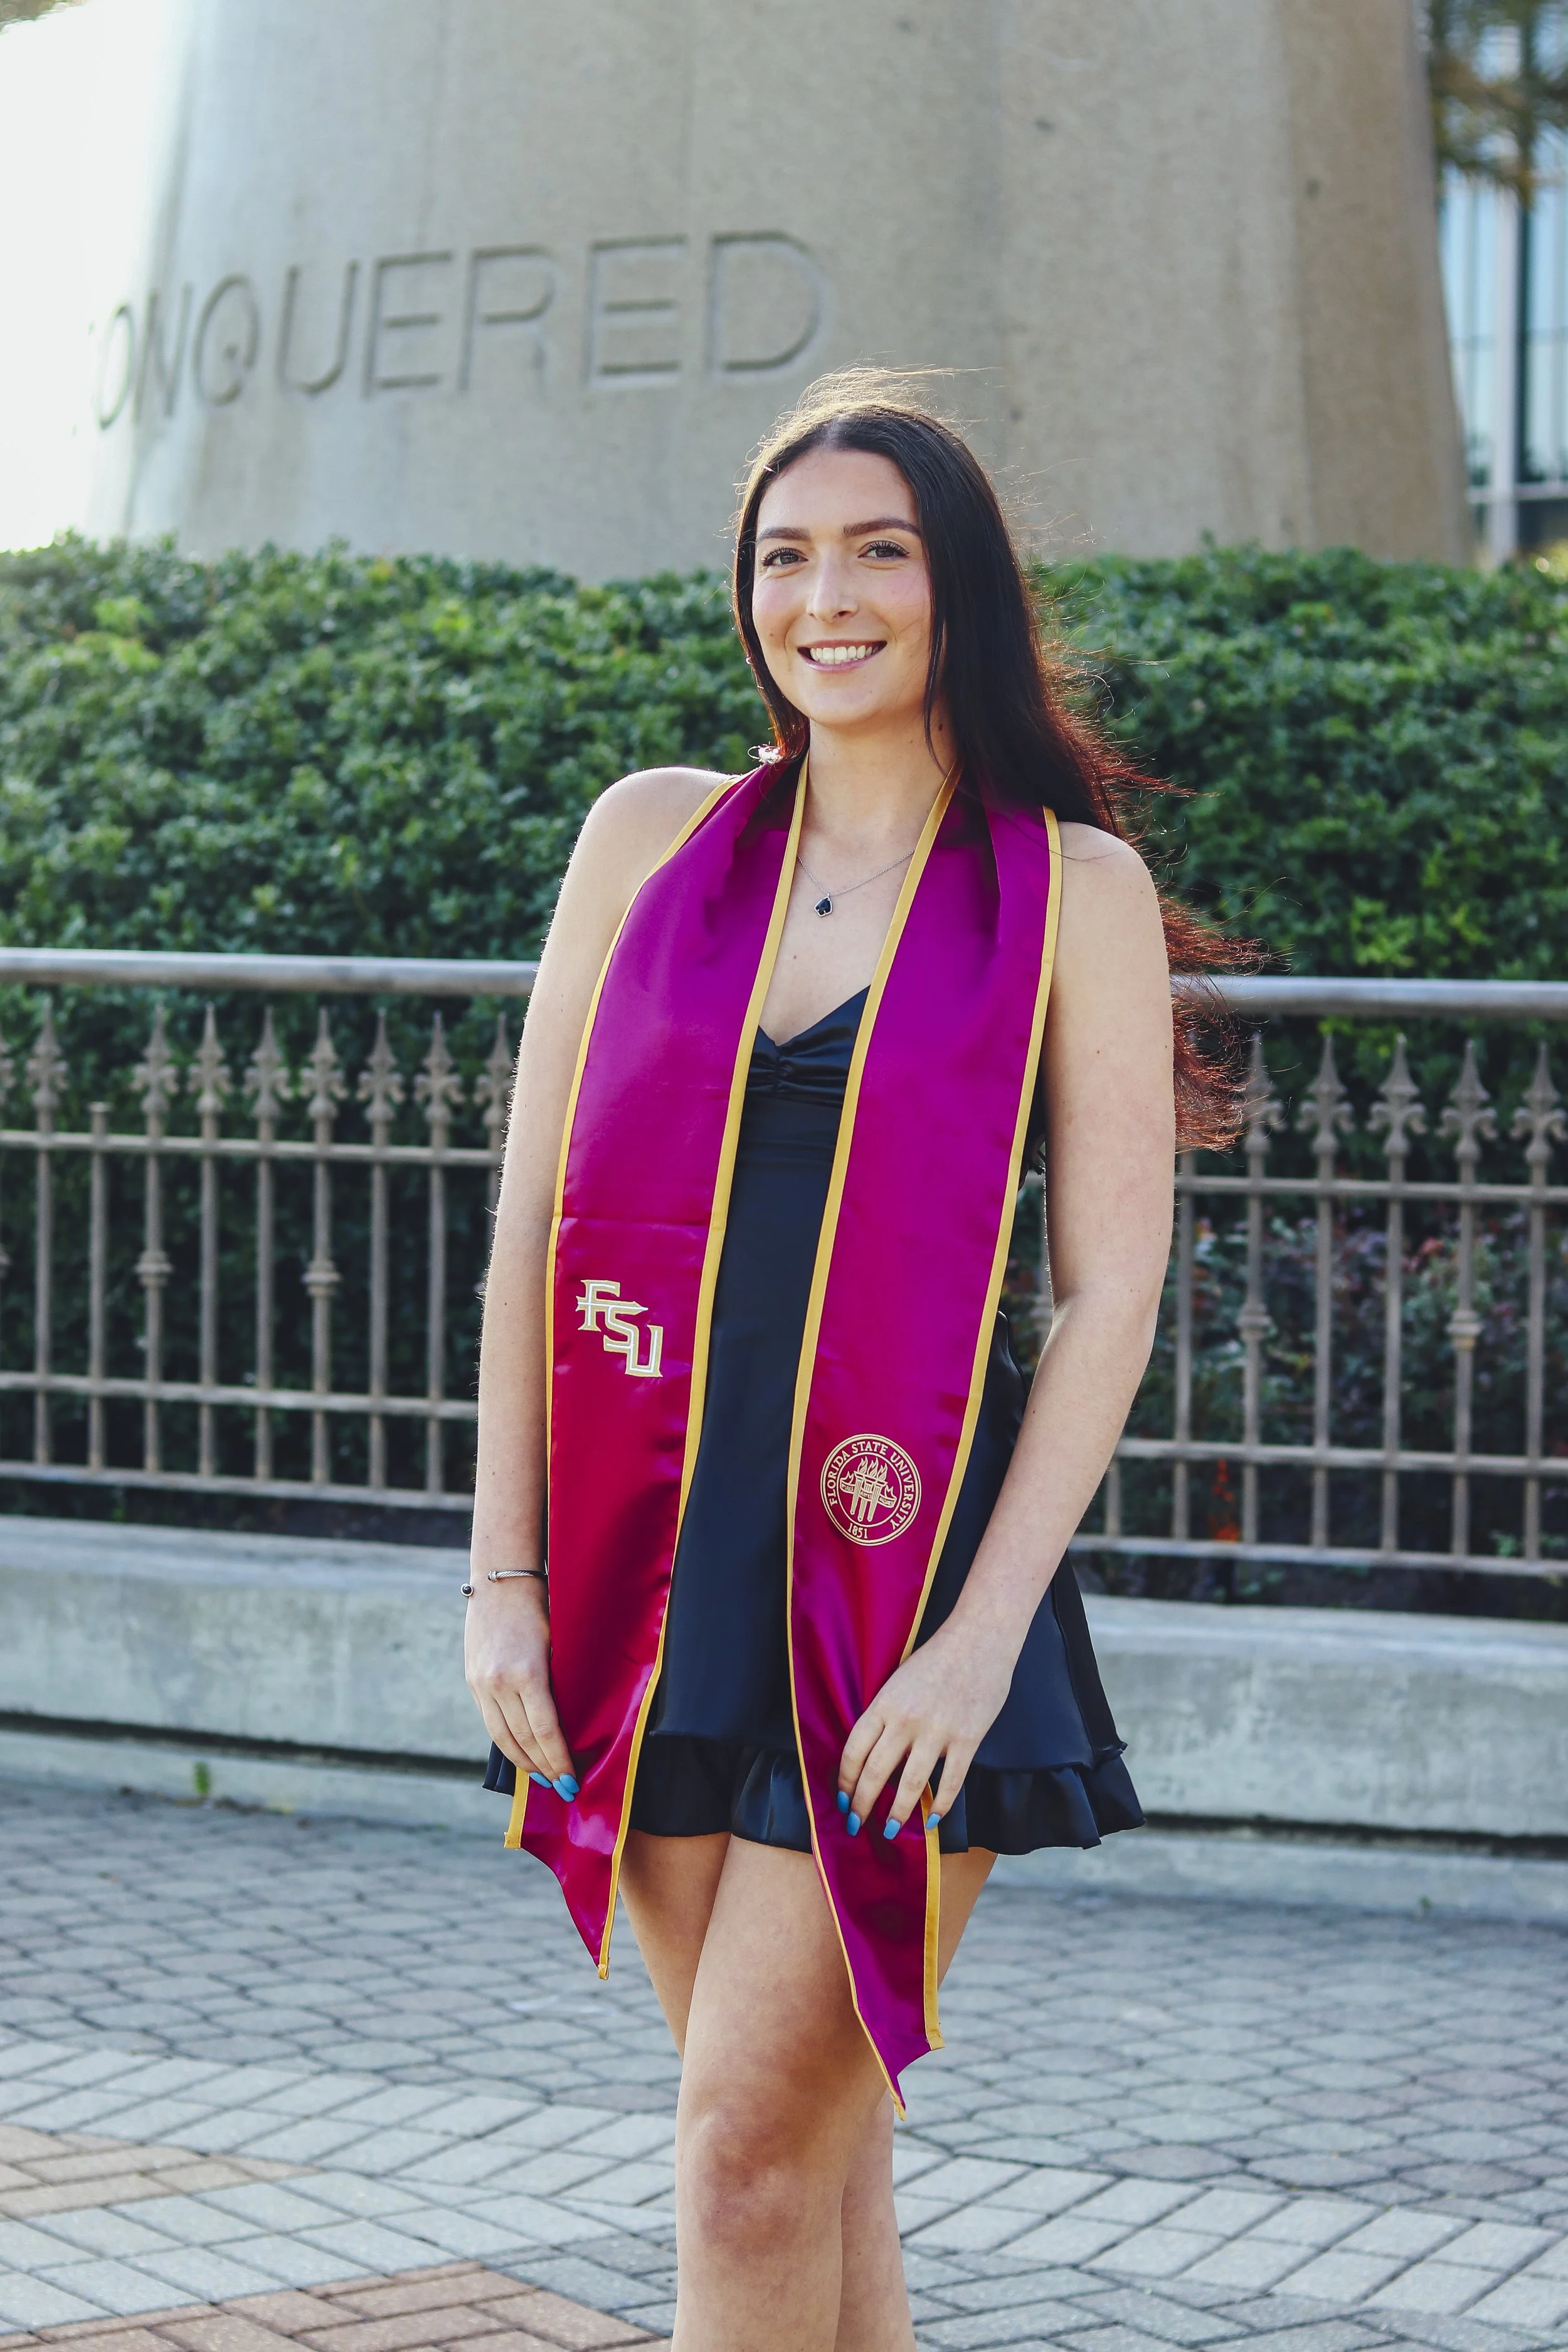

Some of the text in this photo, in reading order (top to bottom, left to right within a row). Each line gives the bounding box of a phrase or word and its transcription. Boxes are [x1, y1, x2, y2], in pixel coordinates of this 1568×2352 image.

[72, 228, 826, 434] ONQUERED
[575, 1279, 664, 1377] FSU
[827, 1441, 915, 1530] FLORIDA STATE UNIVERSITY
[847, 1523, 868, 1539] 1851
